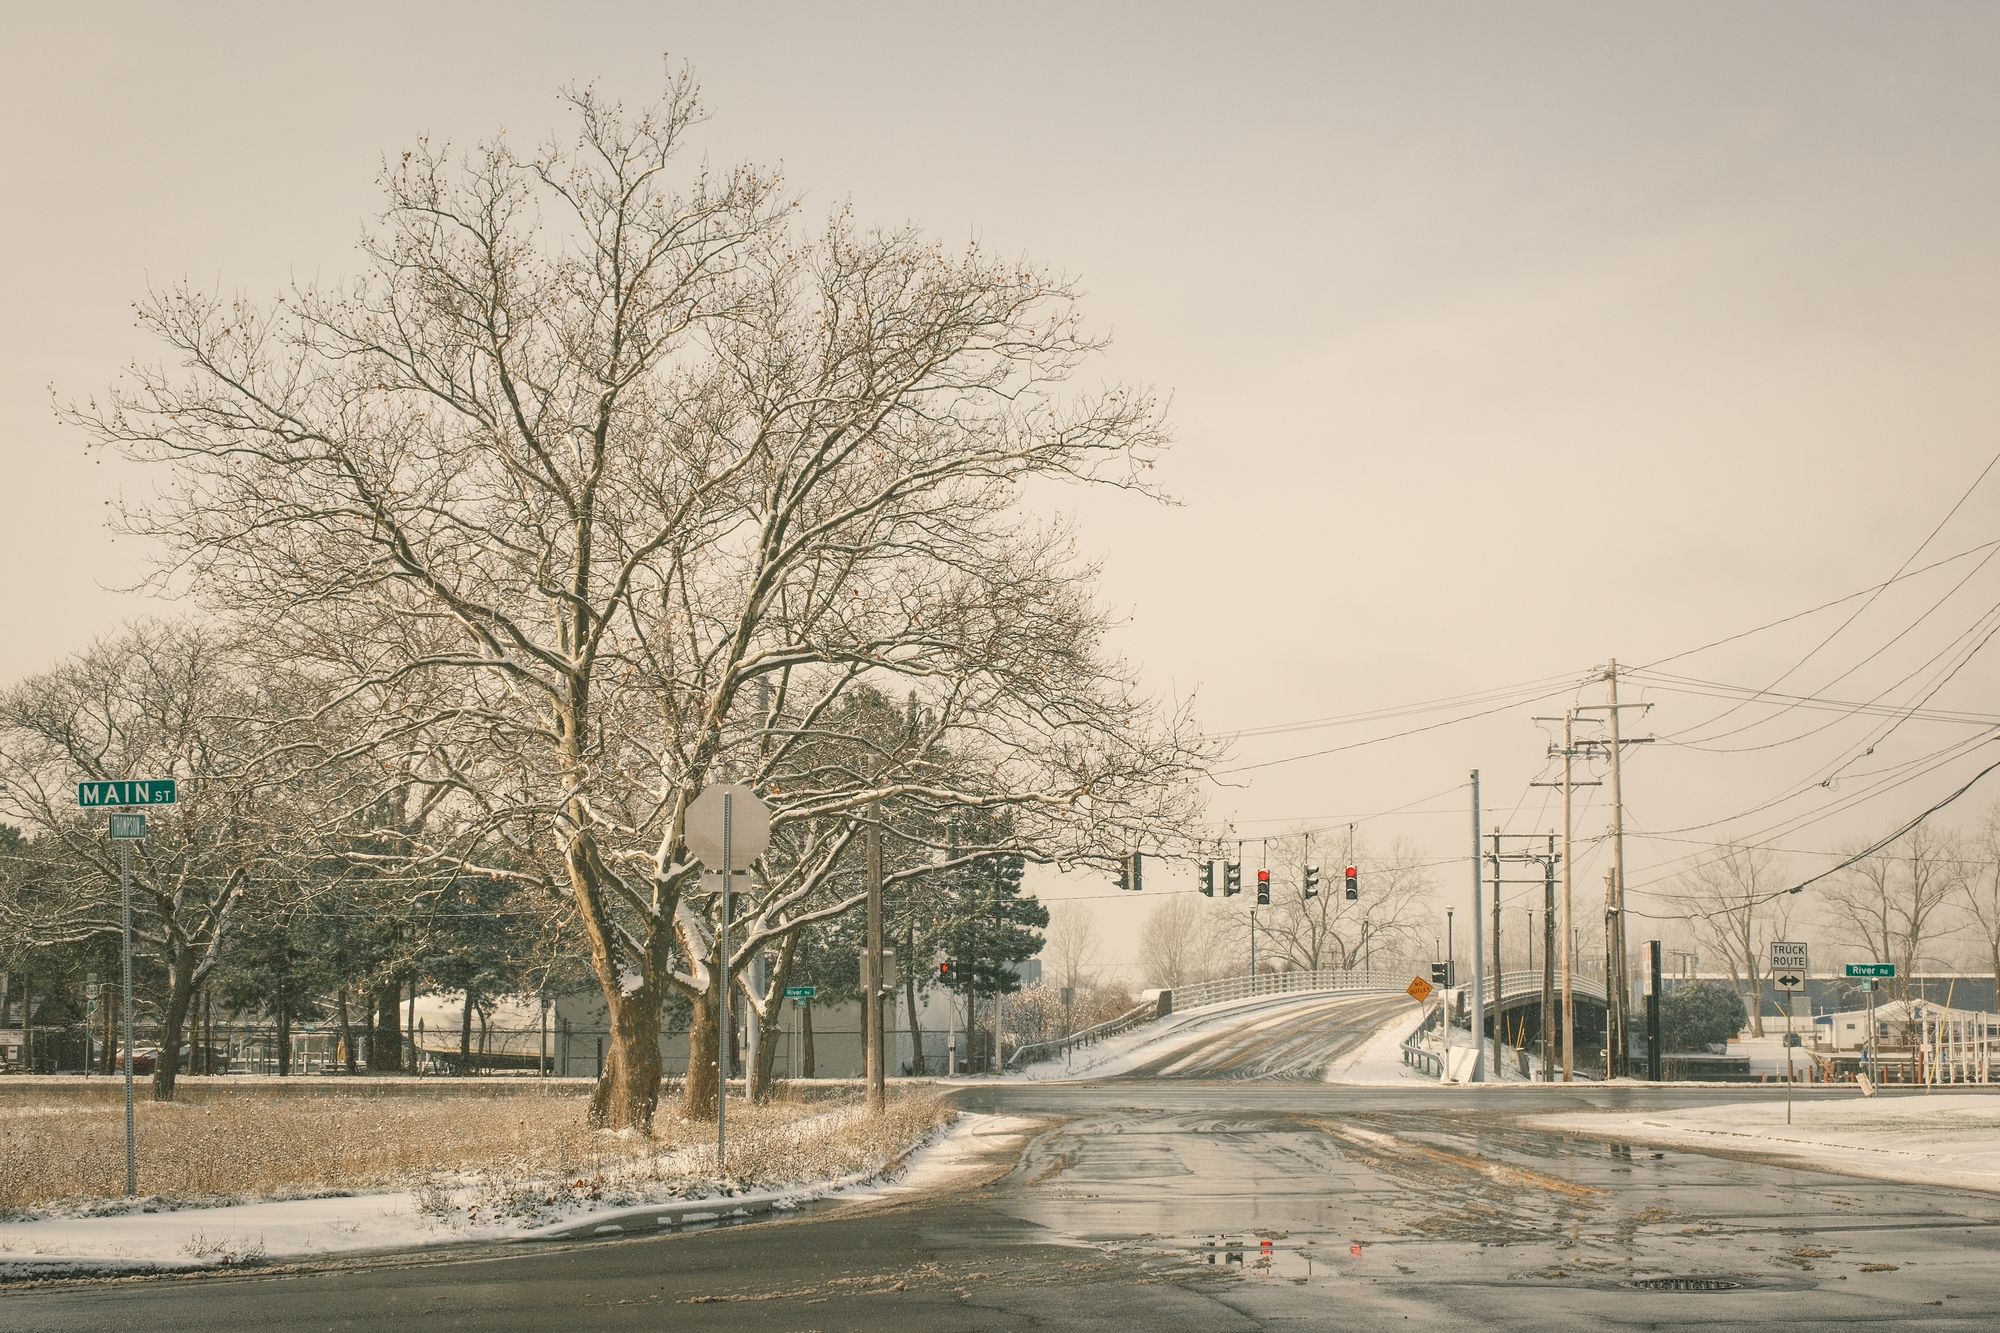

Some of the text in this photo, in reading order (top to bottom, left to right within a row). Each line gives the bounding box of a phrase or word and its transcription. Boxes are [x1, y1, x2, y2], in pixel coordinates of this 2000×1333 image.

[83, 783, 171, 804] MAIN ST
[113, 816, 140, 836] THOMPSON
[1773, 945, 1805, 955] TRUCK
[1773, 956, 1804, 966] ROUTE
[1852, 966, 1876, 975] River
[1409, 986, 1430, 994] OUTLET
